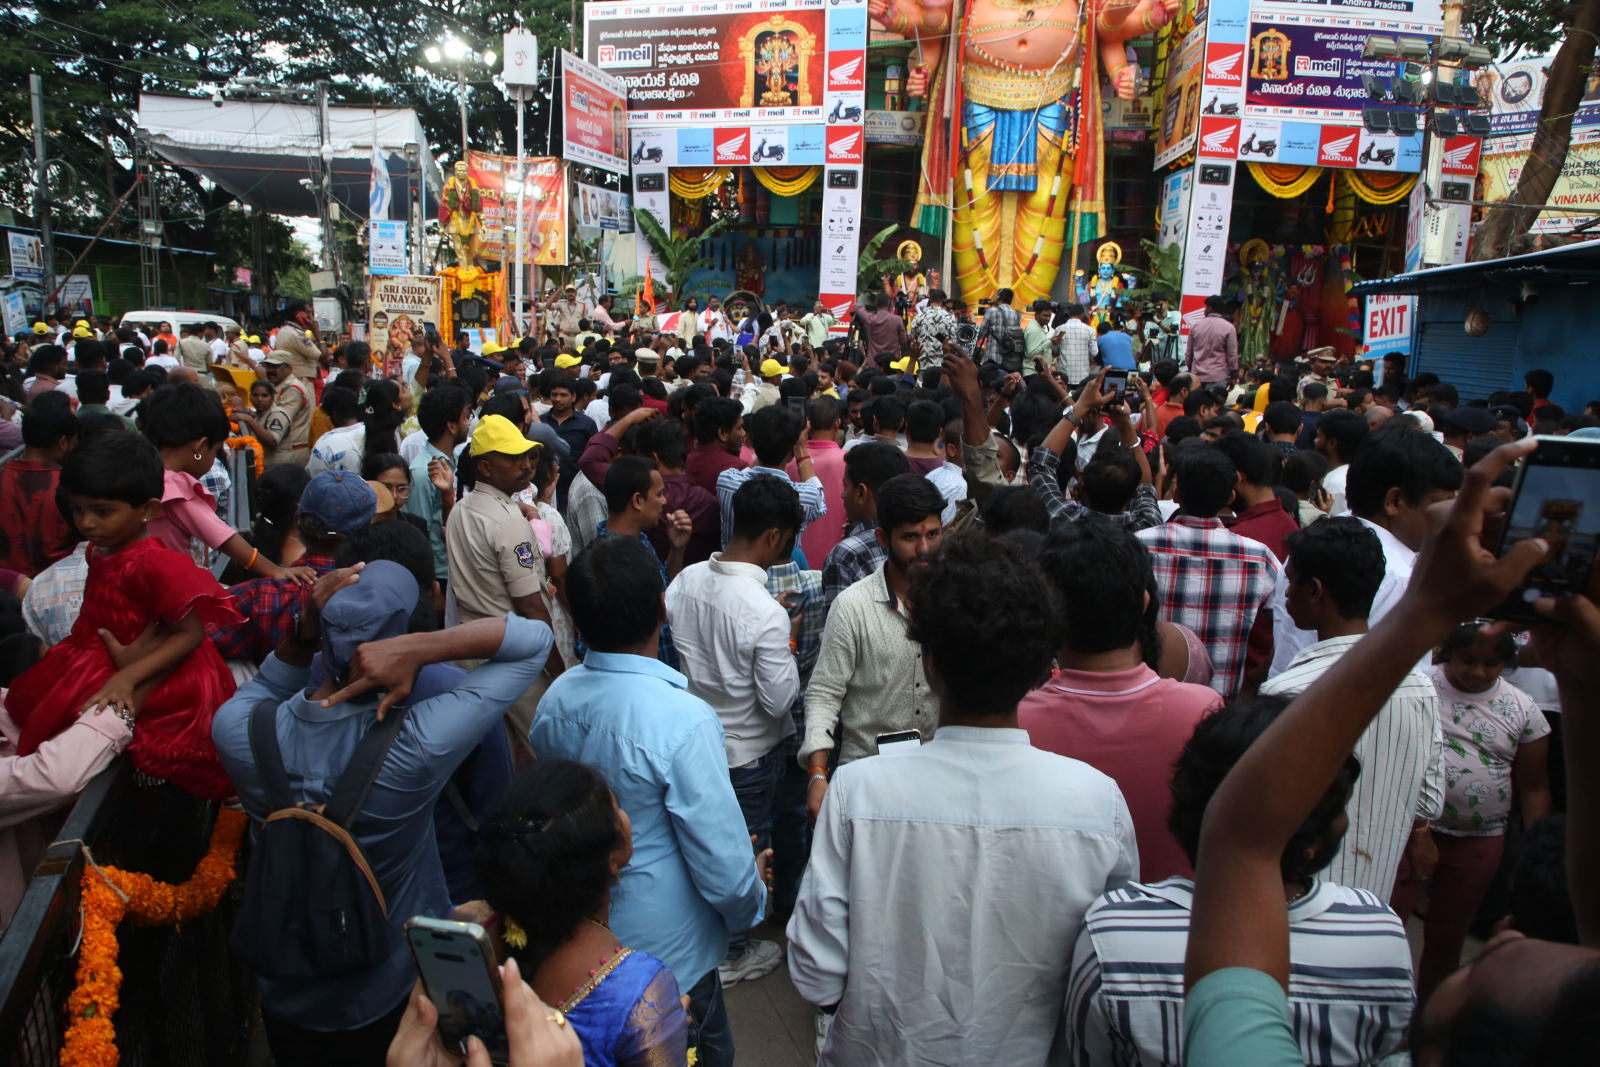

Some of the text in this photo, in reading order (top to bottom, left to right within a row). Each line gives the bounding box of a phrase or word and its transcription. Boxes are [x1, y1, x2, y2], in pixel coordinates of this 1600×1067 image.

[1342, 0, 1407, 11] Andhra Pradesh
[618, 45, 651, 61] meil
[1312, 60, 1340, 72] meil
[1207, 73, 1241, 81] HONDA
[1202, 146, 1235, 154] HONDA
[1321, 154, 1354, 163] HONDA
[1442, 162, 1474, 170] HONDA
[383, 285, 428, 296] SRI SIDDI
[380, 293, 432, 306] VINAYAKA
[1369, 304, 1407, 339] EXIT
